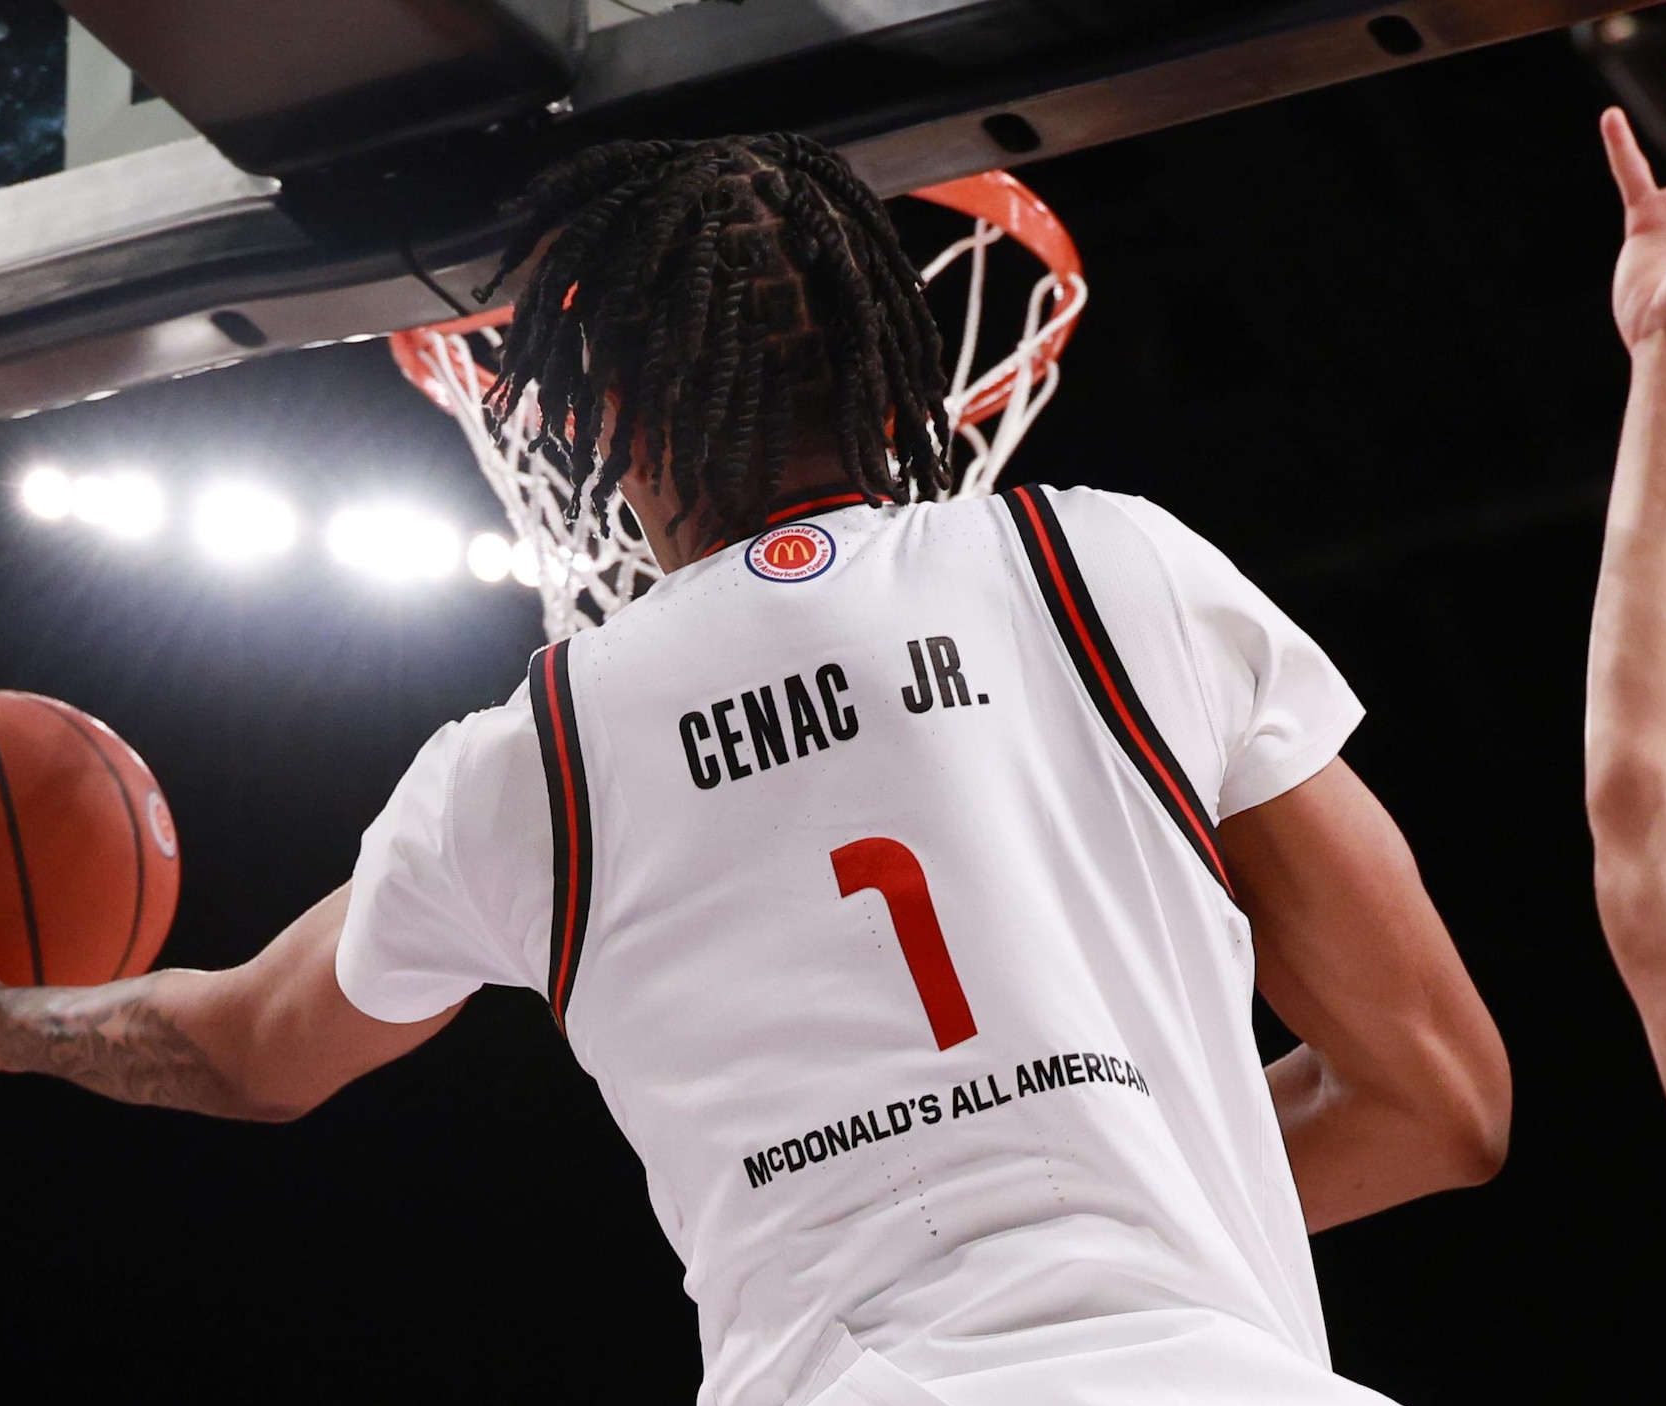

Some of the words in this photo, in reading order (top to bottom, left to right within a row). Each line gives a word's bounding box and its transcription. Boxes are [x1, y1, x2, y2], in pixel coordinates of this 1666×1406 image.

[758, 528, 818, 545] McDonald's
[760, 565, 808, 578] American
[807, 549, 829, 571] Games
[678, 662, 860, 790] CENAC
[900, 635, 991, 714] JR.
[829, 836, 979, 1052] 1
[951, 1074, 1012, 1119] ALL
[1014, 1052, 1151, 1098] AMERICAN
